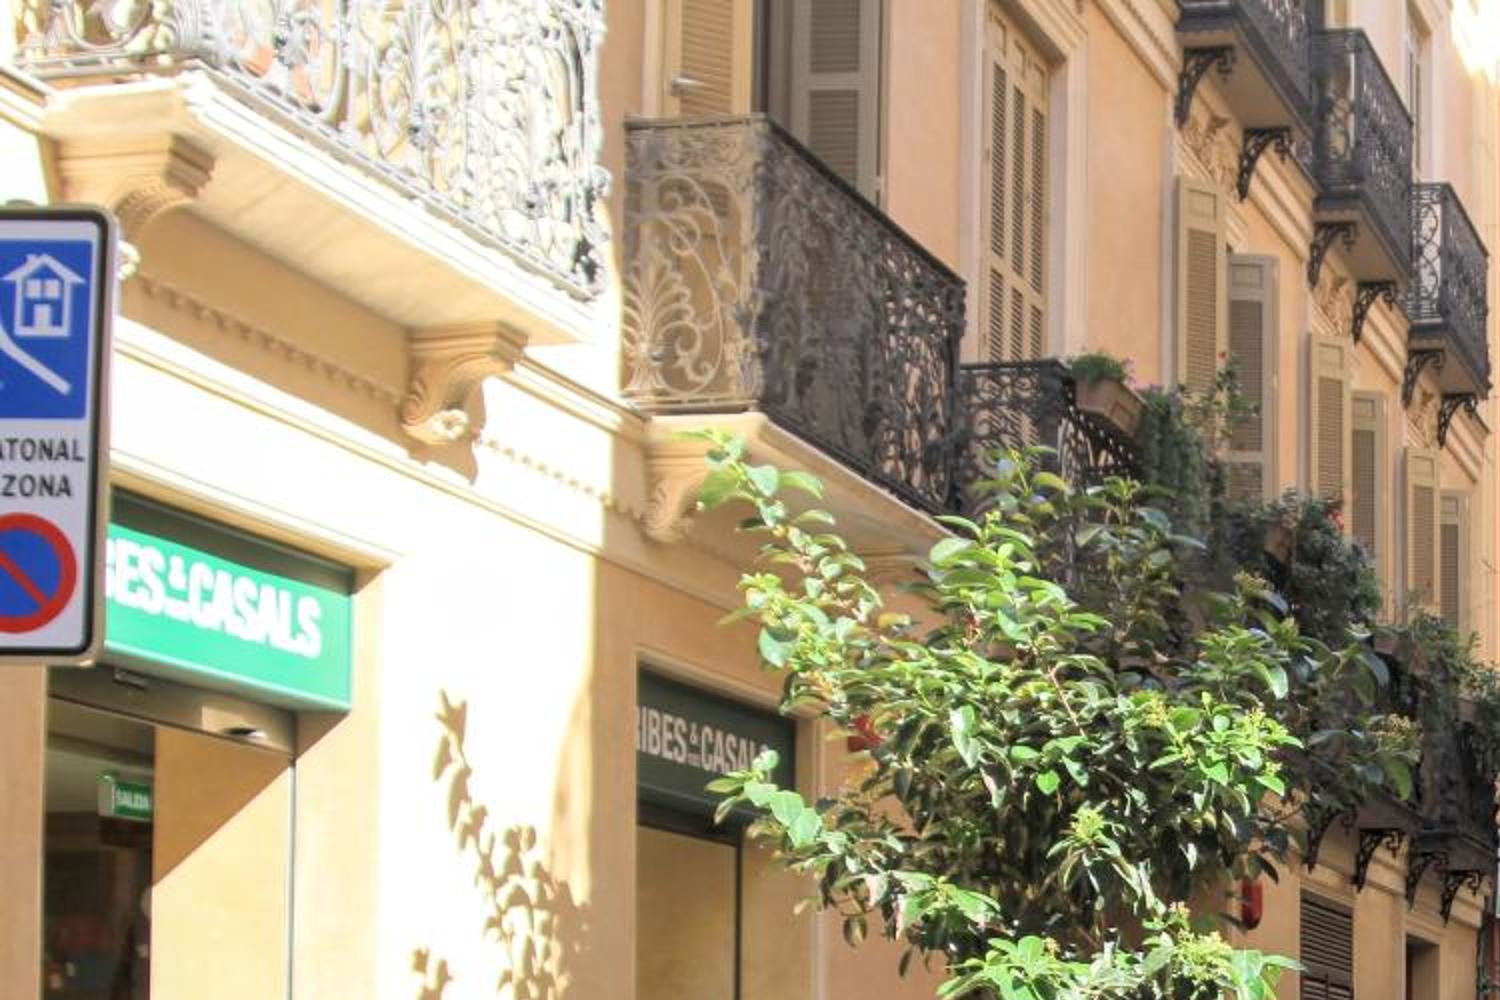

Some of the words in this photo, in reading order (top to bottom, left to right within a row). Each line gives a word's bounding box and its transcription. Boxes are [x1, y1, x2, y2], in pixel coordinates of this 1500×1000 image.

[0, 437, 85, 461] TONAL
[1, 474, 72, 497] ZONA
[188, 561, 322, 660] CASALS
